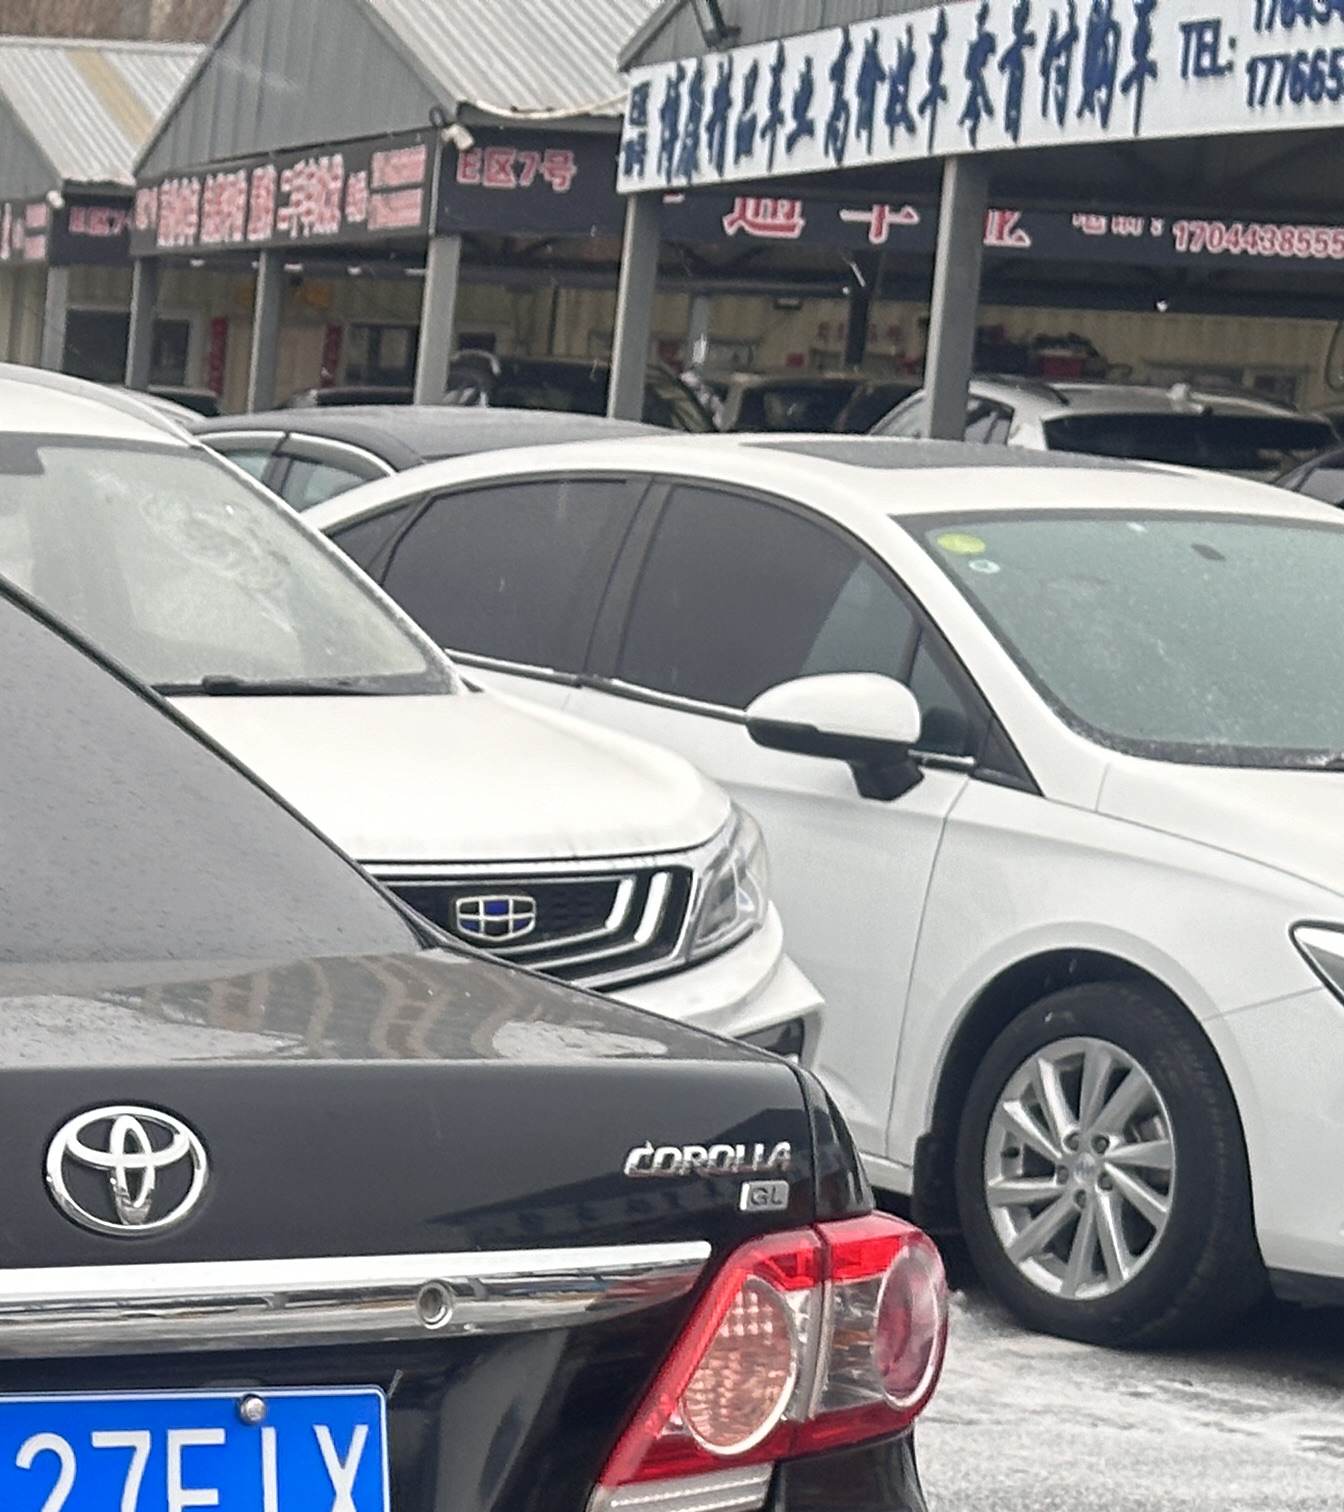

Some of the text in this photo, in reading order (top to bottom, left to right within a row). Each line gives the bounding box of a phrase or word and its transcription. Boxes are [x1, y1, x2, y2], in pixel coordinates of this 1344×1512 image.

[456, 147, 577, 192] E区7号
[624, 1140, 792, 1178] COROLLA
[749, 1186, 783, 1207] GL
